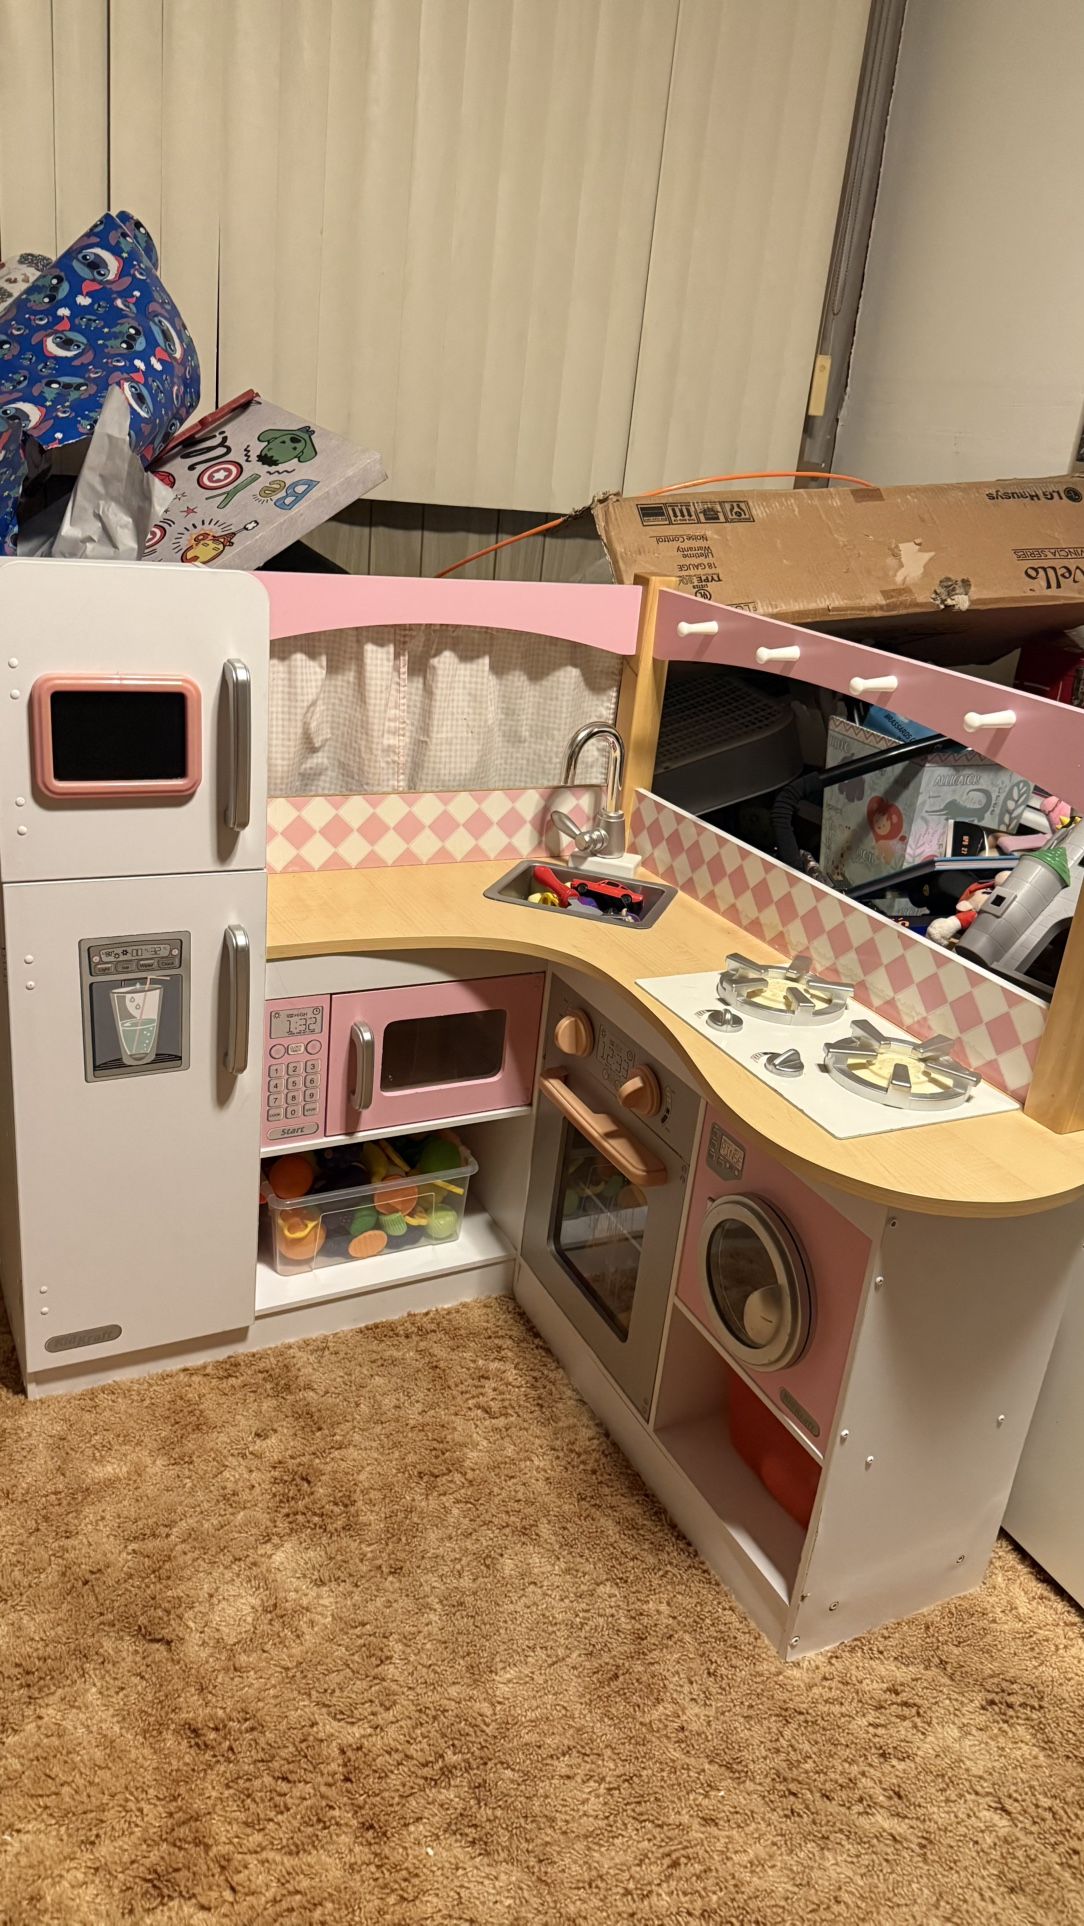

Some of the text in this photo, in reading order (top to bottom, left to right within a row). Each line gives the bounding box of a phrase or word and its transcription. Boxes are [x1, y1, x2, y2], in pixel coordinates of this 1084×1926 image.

[1043, 489, 1063, 501] LG
[655, 534, 708, 544] Noise Control
[676, 545, 713, 554] Warranty
[1013, 549, 1048, 559] SERIES
[681, 552, 714, 560] Lifetime
[677, 562, 717, 571] 18 GAUGE
[696, 574, 722, 584] TYPE
[292, 1065, 298, 1073] 2
[273, 1077, 315, 1090] 4 5 6
[280, 1125, 305, 1136] Start
